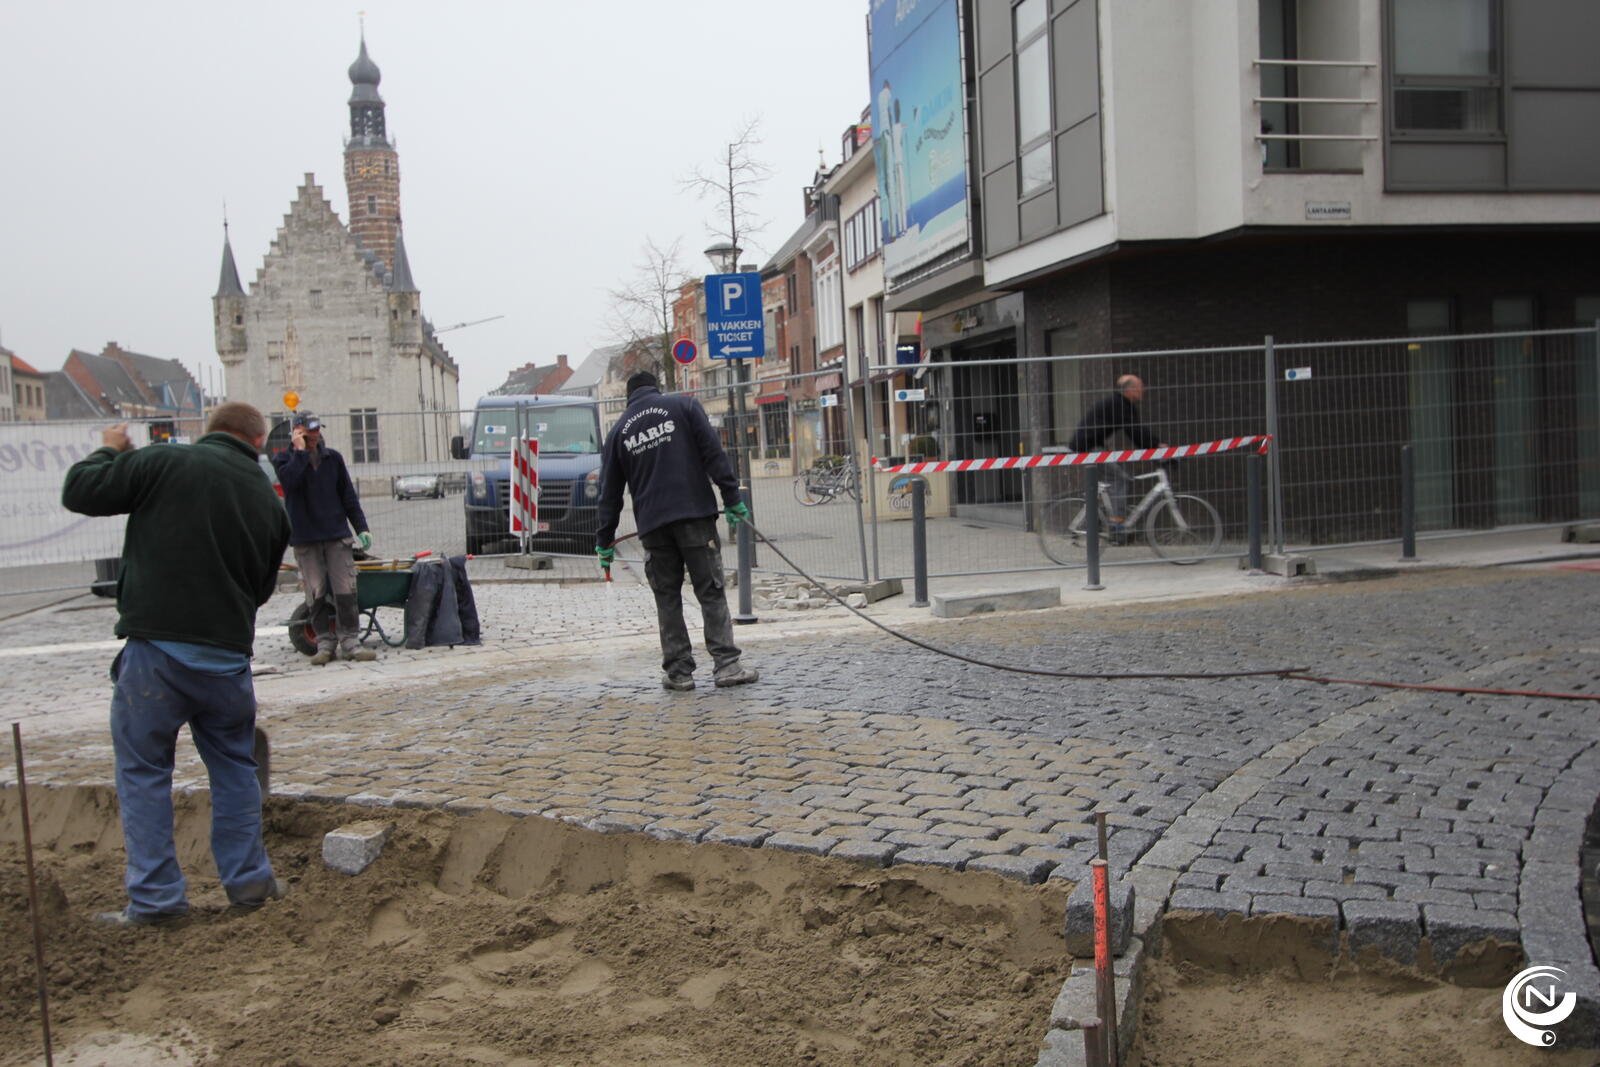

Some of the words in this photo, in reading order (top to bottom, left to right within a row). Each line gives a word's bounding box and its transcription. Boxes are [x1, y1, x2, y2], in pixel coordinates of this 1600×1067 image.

[723, 282, 743, 311] P
[708, 322, 718, 332] IN
[720, 319, 761, 332] VAKKEN
[717, 331, 753, 343] TICKET
[623, 420, 676, 452] MARIS
